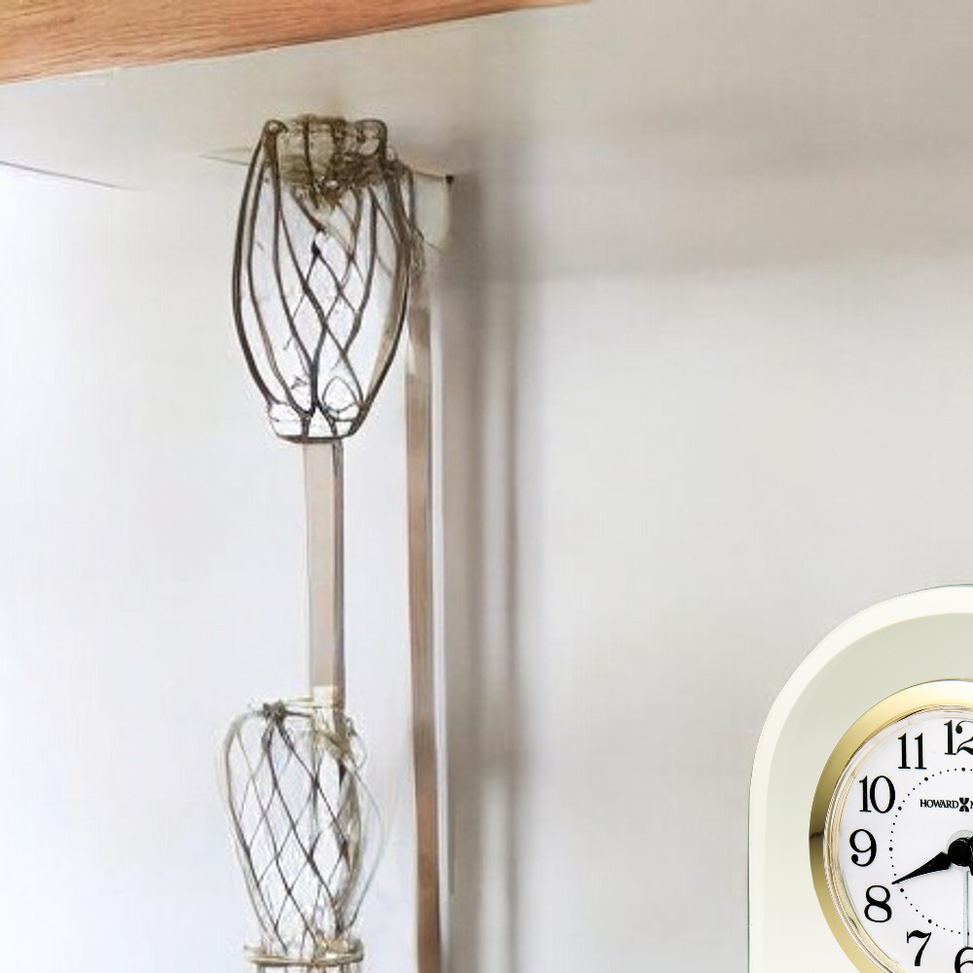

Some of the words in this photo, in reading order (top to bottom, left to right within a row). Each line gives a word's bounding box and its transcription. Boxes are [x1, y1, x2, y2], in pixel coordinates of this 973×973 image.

[898, 732, 928, 770] 11
[859, 775, 896, 814] 10
[920, 799, 959, 809] HOWARD
[849, 828, 877, 867] 9
[864, 885, 893, 923] 8
[906, 929, 932, 967] 7
